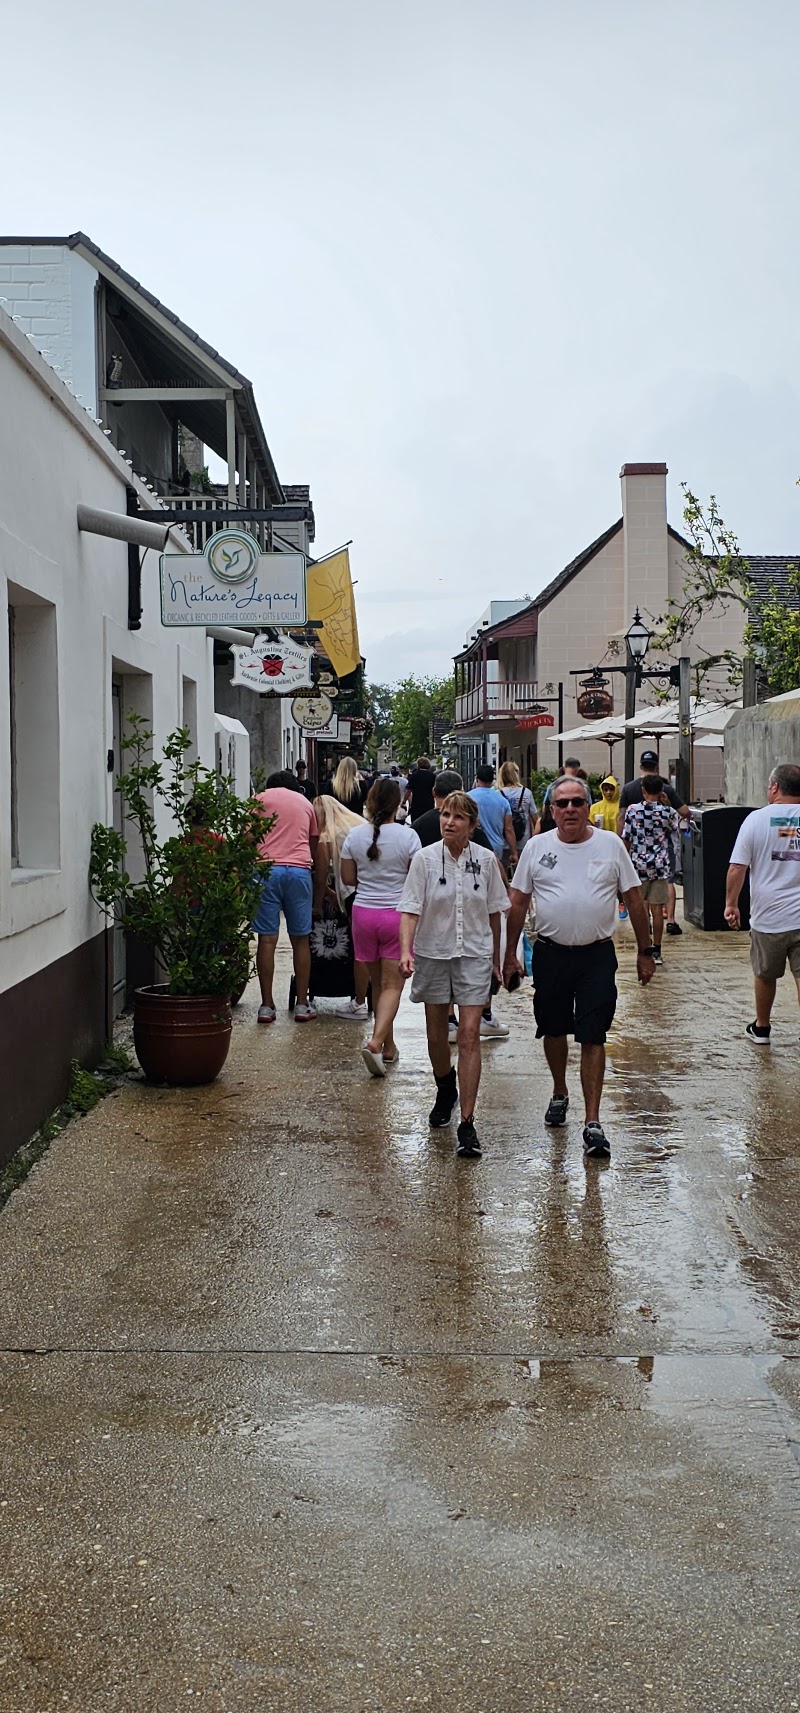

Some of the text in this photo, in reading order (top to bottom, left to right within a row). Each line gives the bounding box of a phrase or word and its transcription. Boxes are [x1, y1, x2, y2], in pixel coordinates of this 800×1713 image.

[184, 571, 203, 583] the
[168, 573, 298, 610] Nature's Legacy
[167, 613, 190, 622] ORGANIC
[219, 612, 239, 621] LEATHER
[240, 612, 258, 621] GOODS
[262, 612, 276, 621] GIFTS
[280, 611, 301, 621] GALLERY
[250, 646, 283, 656] Augustine
[284, 647, 307, 662] Textiles
[524, 717, 552, 727] TICKETS
